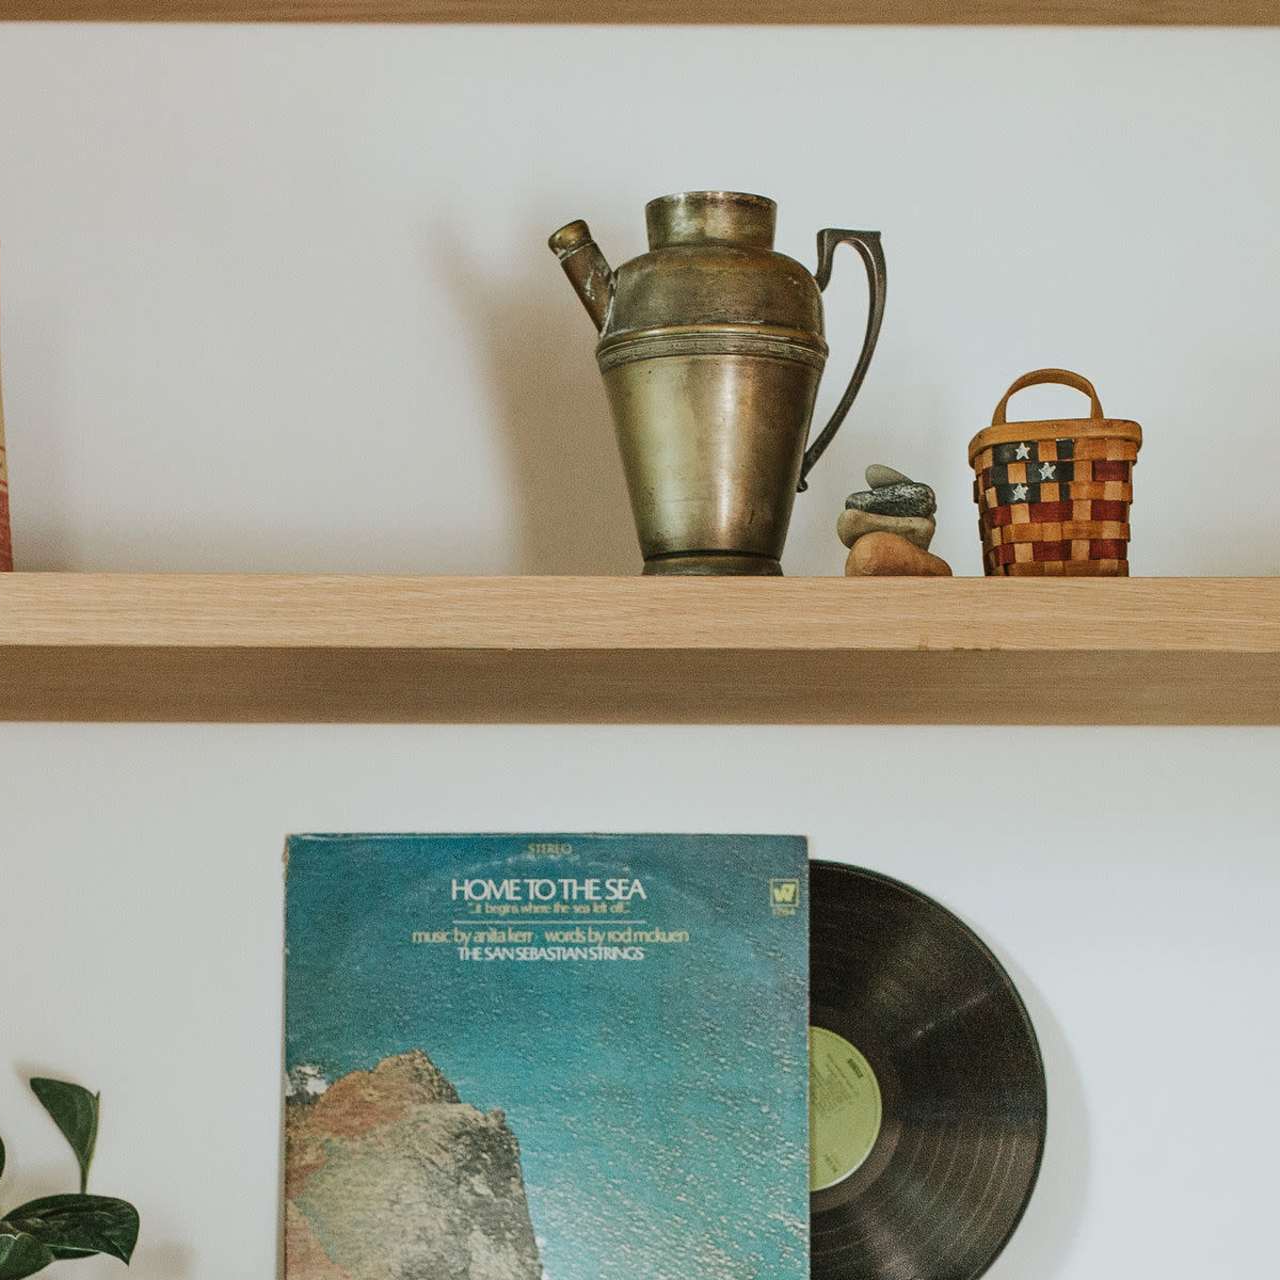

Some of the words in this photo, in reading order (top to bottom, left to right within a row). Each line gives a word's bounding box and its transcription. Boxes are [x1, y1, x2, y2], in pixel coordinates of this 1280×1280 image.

[451, 878, 522, 901] HOME
[523, 878, 556, 901] TO
[557, 878, 602, 901] THE
[604, 878, 648, 901] SEA
[411, 929, 449, 943] music
[453, 927, 471, 947] by
[473, 928, 506, 943] anita
[507, 927, 534, 943] kerr
[544, 926, 586, 943] words
[587, 926, 607, 947] by
[607, 926, 632, 943] rod
[633, 926, 690, 943] mckuen
[457, 946, 483, 961] THE
[484, 946, 515, 961] SAN
[515, 946, 588, 961] SEBASTIAN
[588, 946, 646, 961] STRINGS
